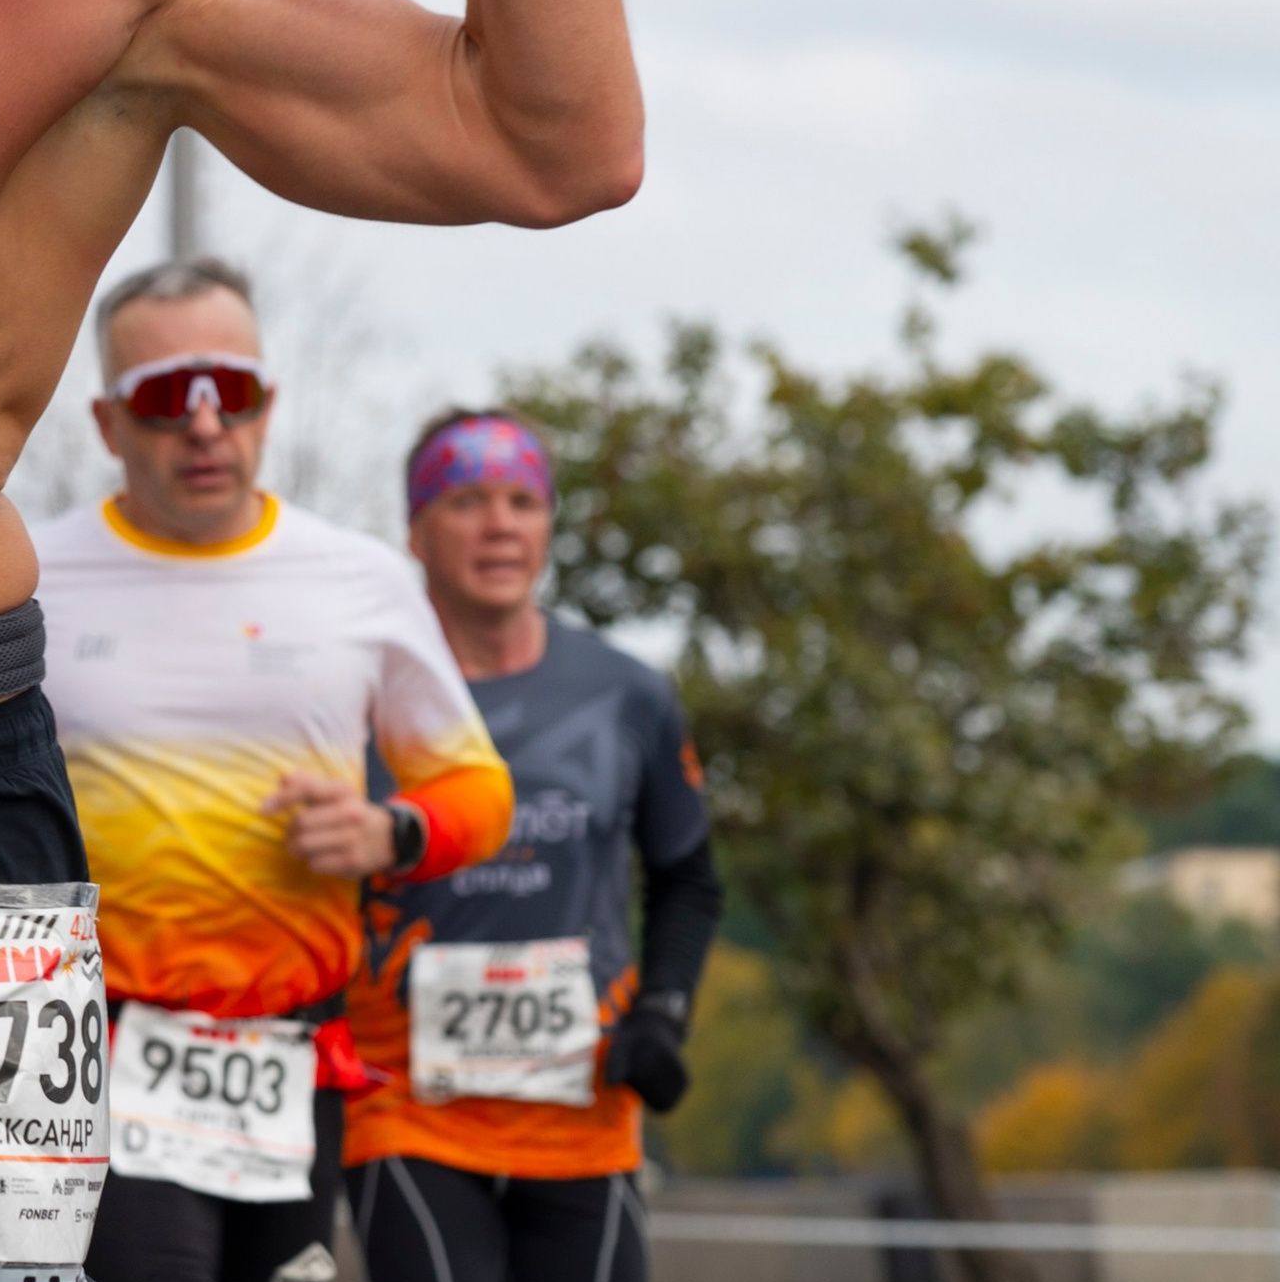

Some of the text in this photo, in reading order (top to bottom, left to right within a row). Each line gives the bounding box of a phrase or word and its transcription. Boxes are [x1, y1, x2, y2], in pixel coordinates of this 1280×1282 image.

[442, 987, 574, 1043] 2705
[142, 1037, 286, 1115] 9503
[19, 1208, 61, 1220] FONBET
